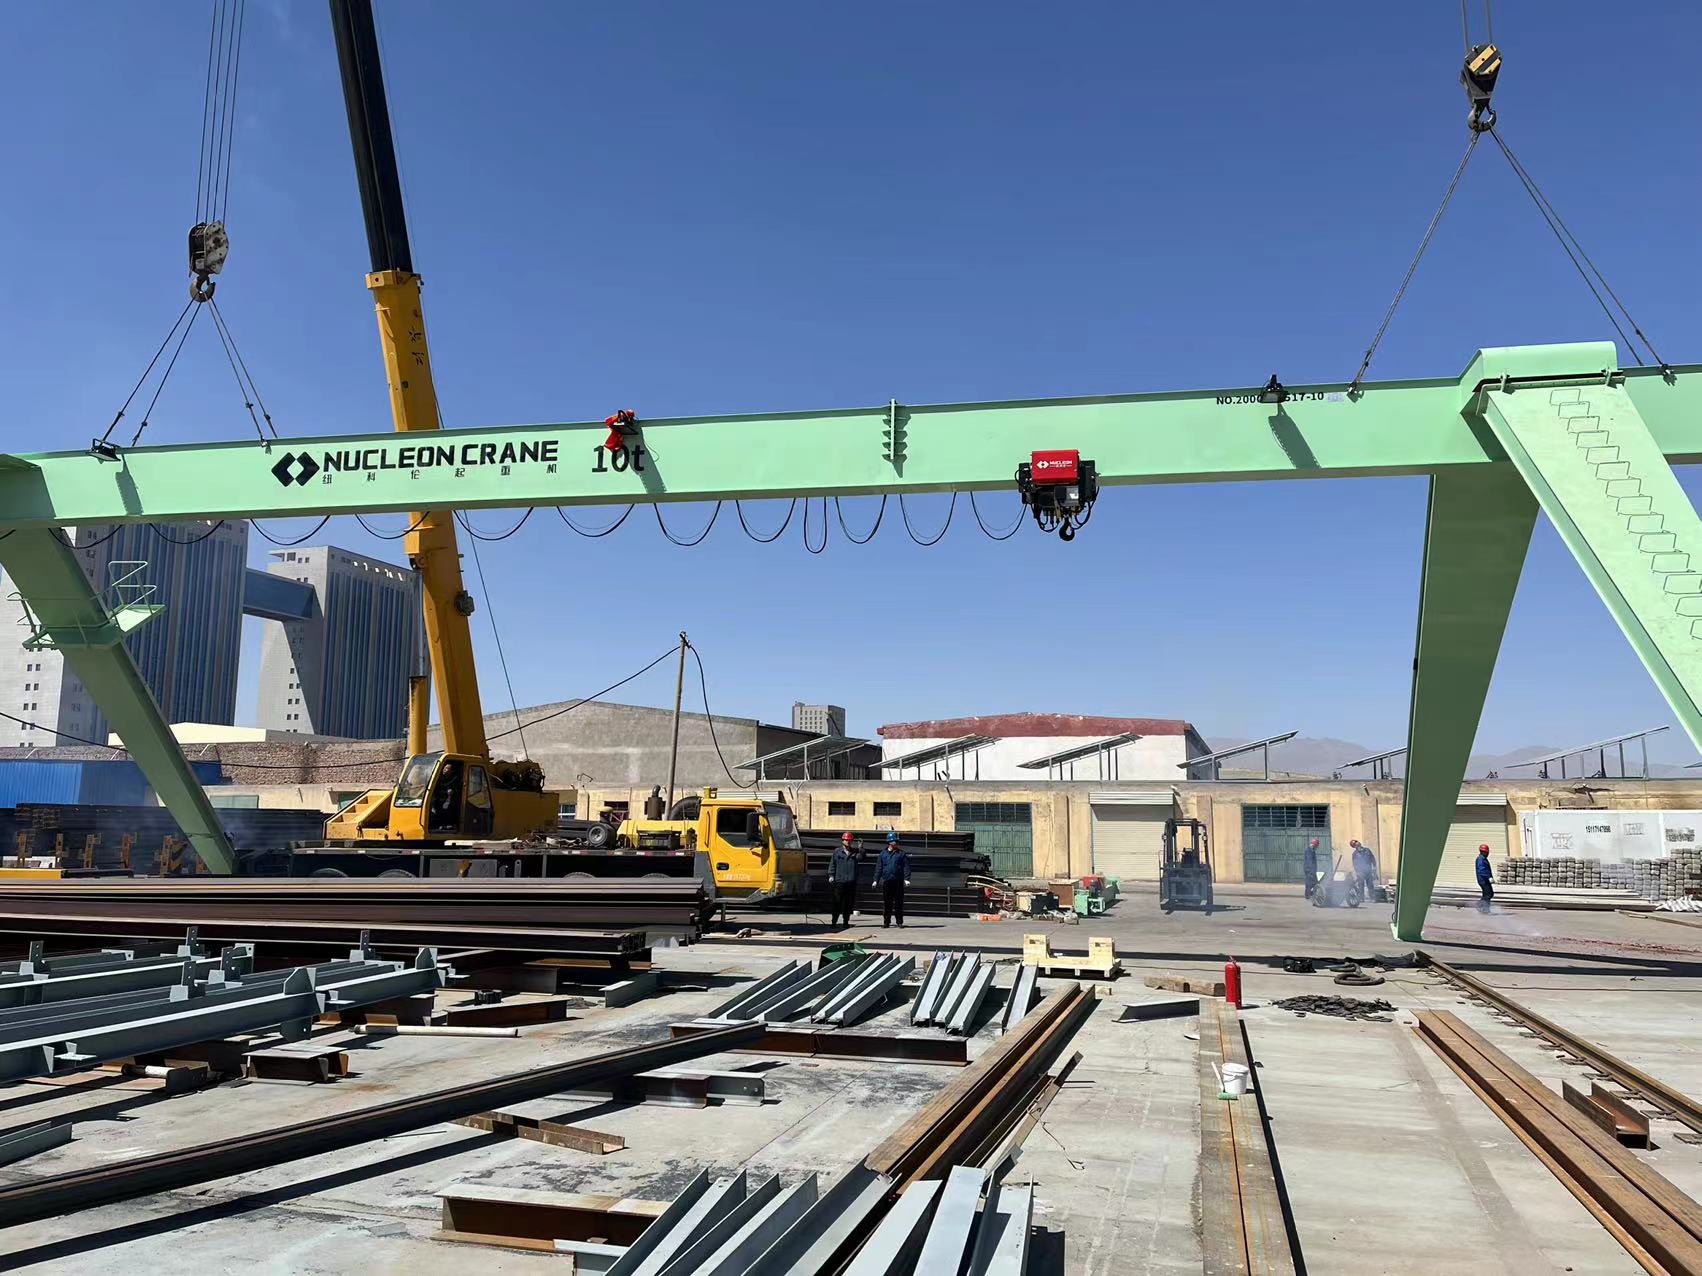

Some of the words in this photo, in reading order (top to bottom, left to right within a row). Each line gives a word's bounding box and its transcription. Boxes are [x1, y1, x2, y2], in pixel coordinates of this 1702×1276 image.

[323, 445, 456, 473] NUCLEON
[461, 440, 559, 466] CRANE
[592, 445, 645, 473] 10t
